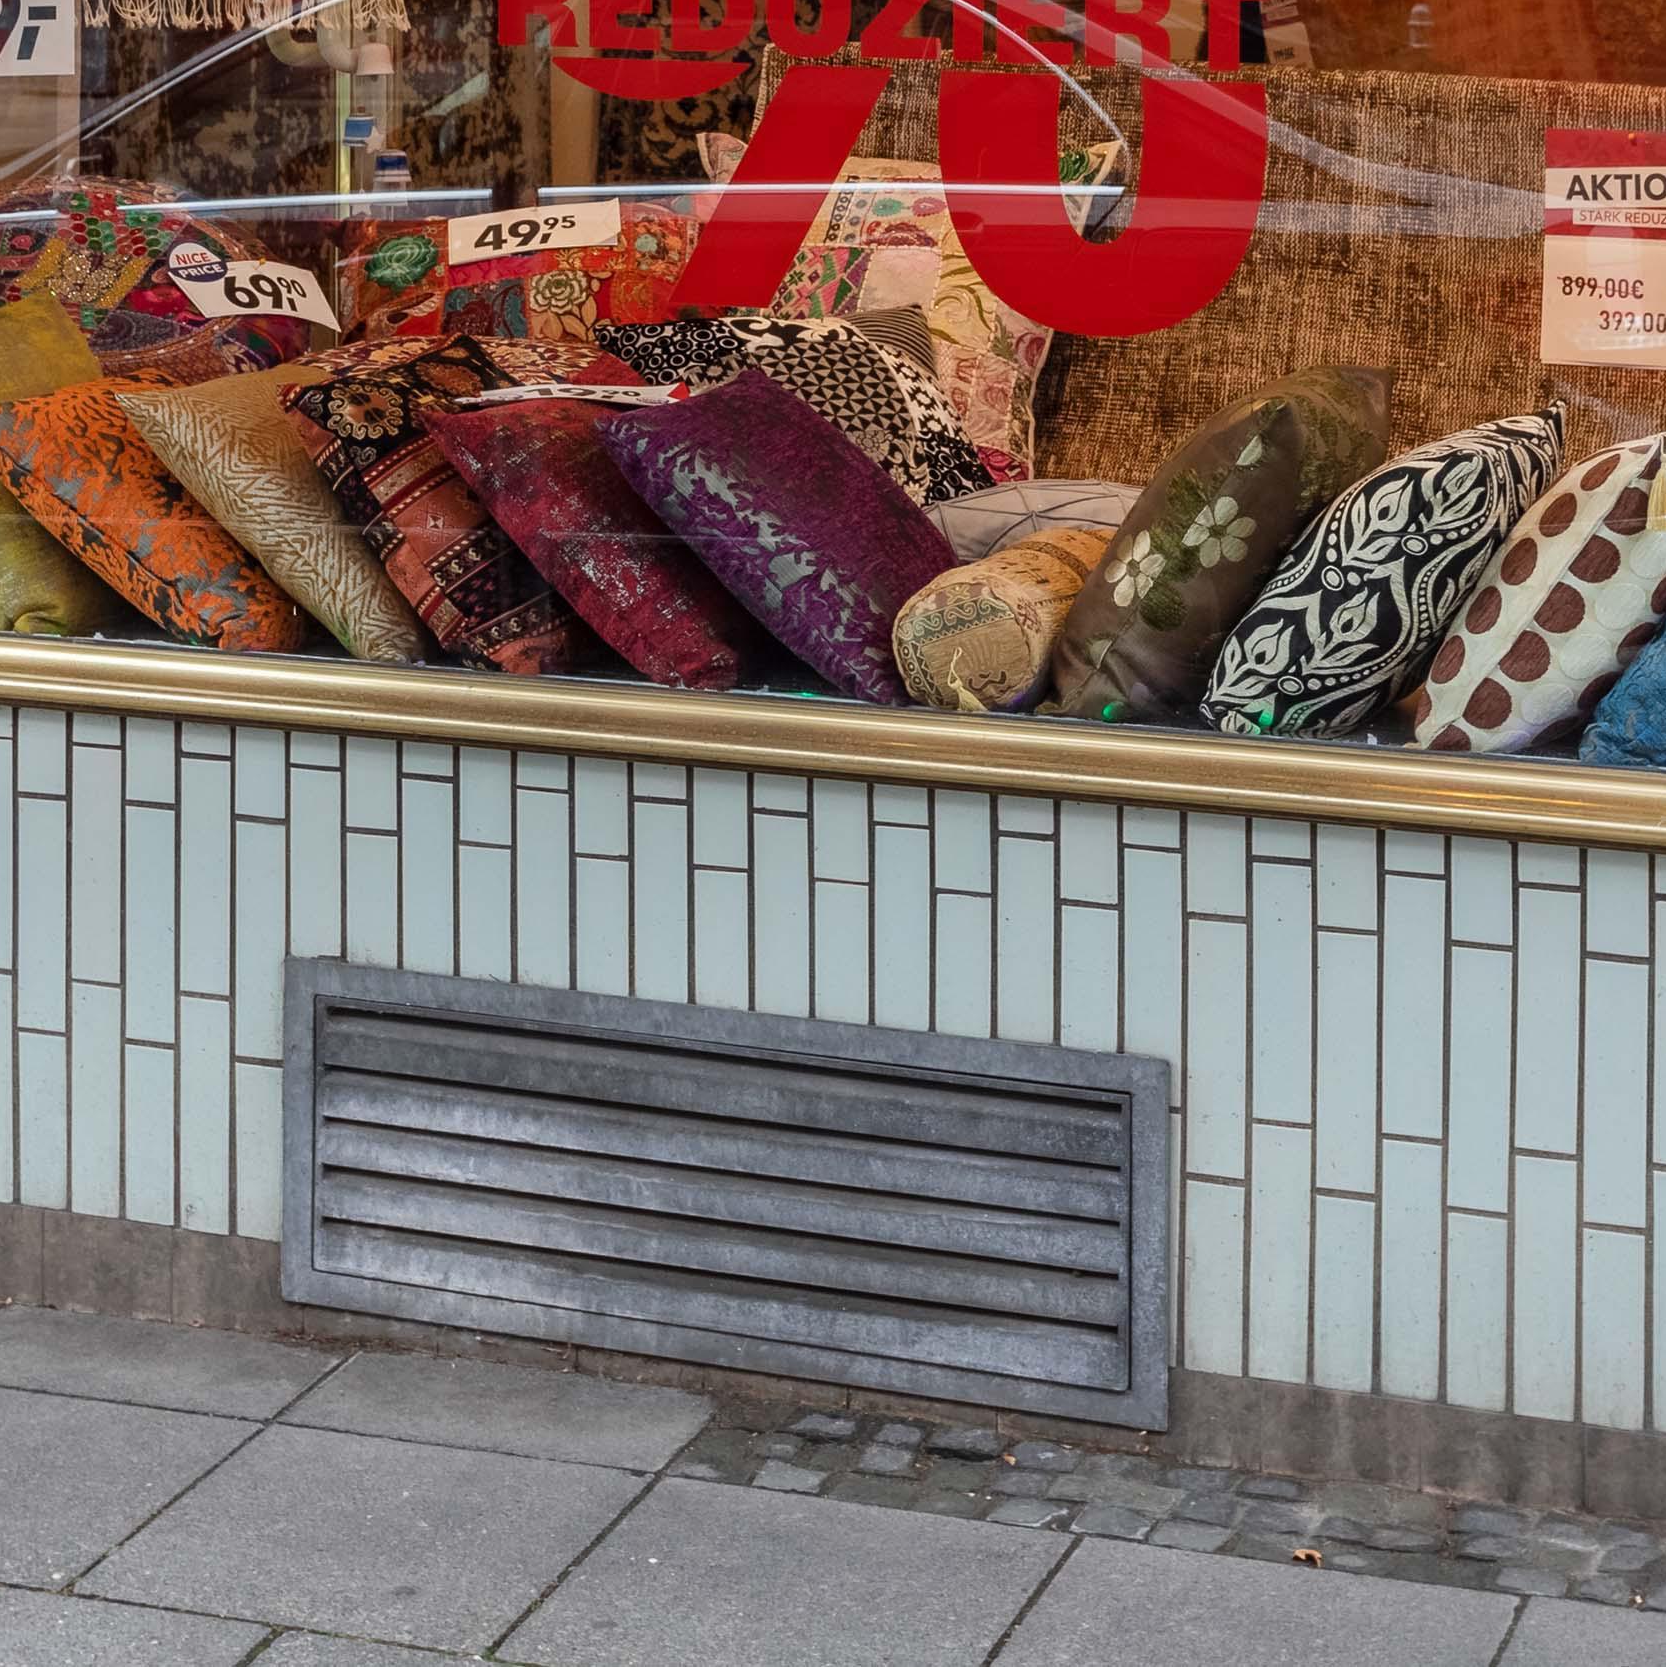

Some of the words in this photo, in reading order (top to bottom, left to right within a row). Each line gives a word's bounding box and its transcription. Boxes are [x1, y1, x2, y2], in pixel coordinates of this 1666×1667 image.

[1579, 209, 1622, 223] STARK
[473, 215, 577, 252] 49,95
[175, 252, 212, 266] NICE
[178, 263, 225, 278] PRICE
[223, 274, 307, 312] 69,90
[1561, 275, 1645, 300] 899,00€
